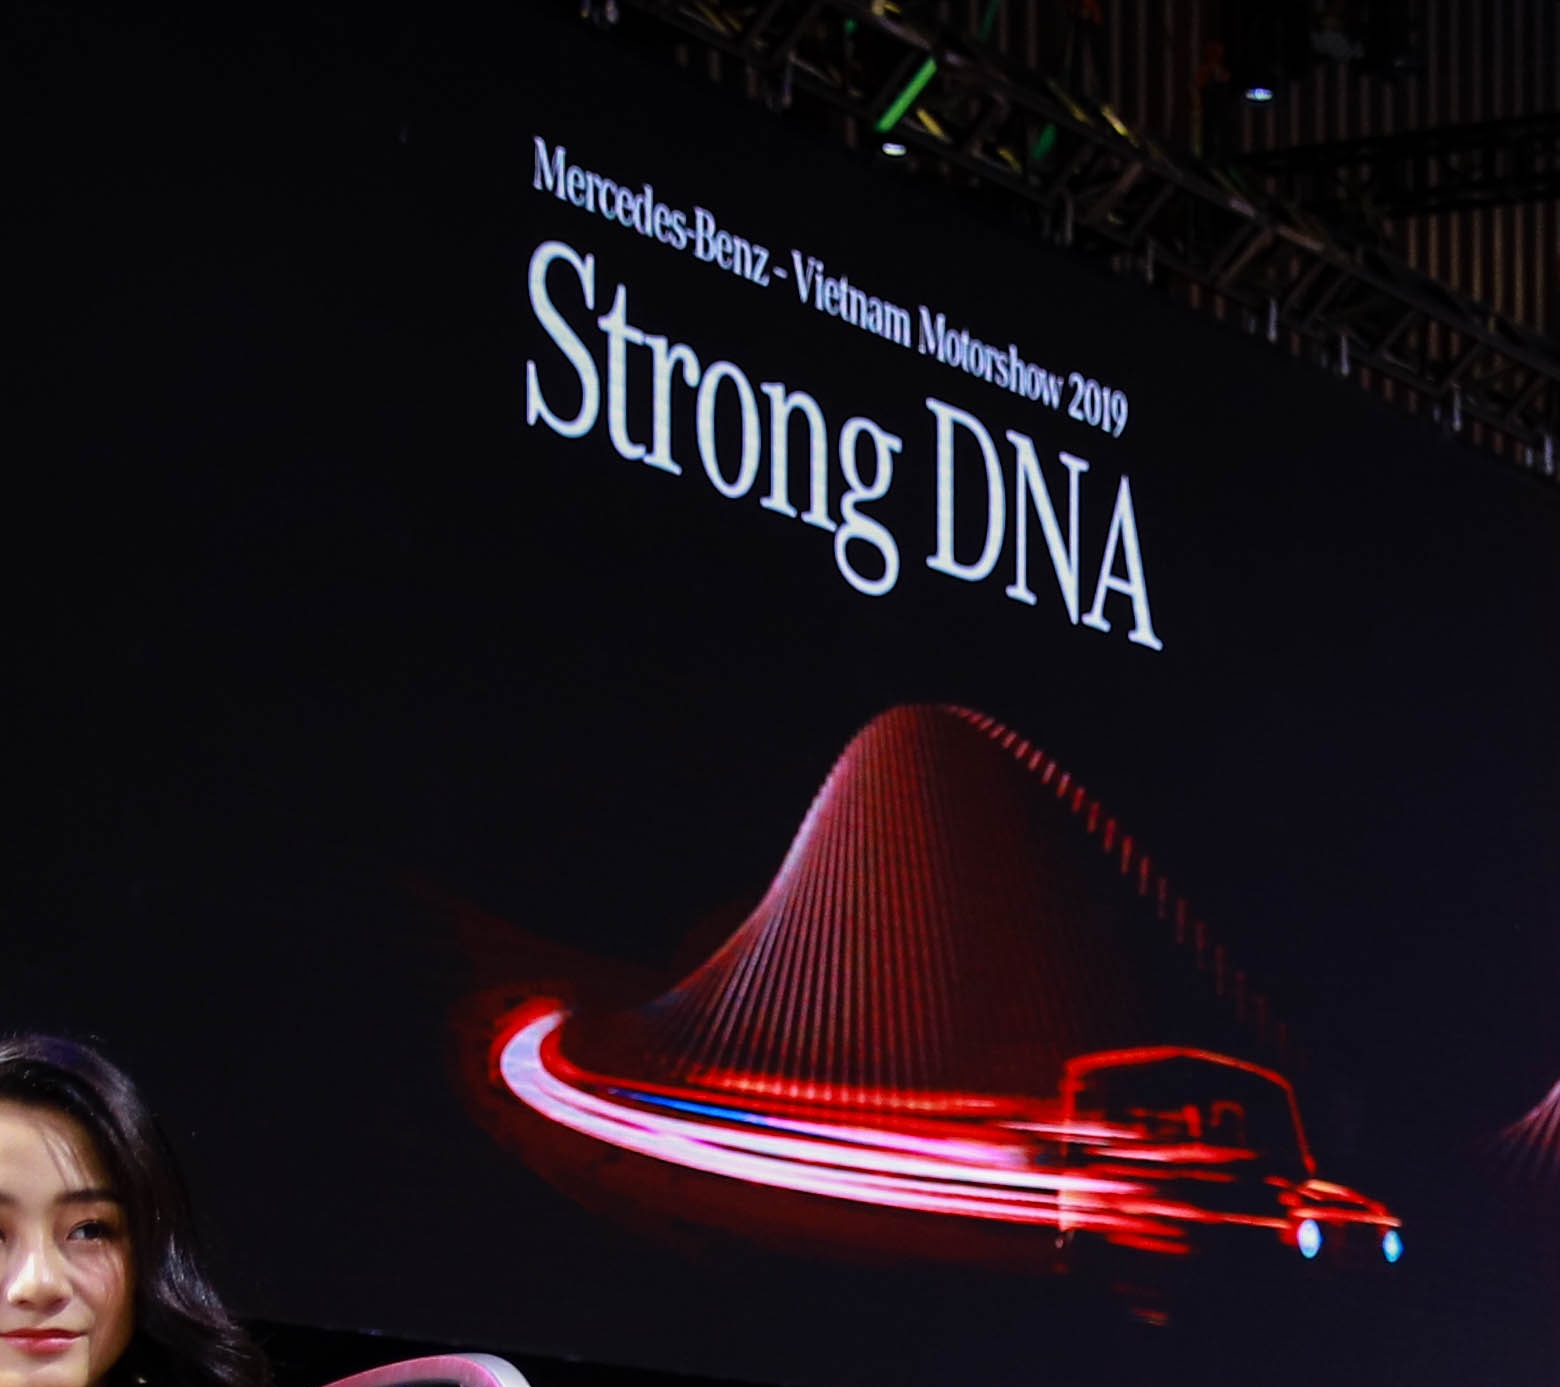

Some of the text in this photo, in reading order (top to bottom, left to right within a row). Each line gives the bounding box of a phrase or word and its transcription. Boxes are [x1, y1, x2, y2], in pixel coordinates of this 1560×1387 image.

[526, 241, 1163, 651] Strong DNA
[533, 136, 770, 287] Mercedes-Benz
[791, 250, 911, 348] Vietnam
[918, 305, 1064, 410] Motorshow
[1068, 372, 1129, 438] 2019
